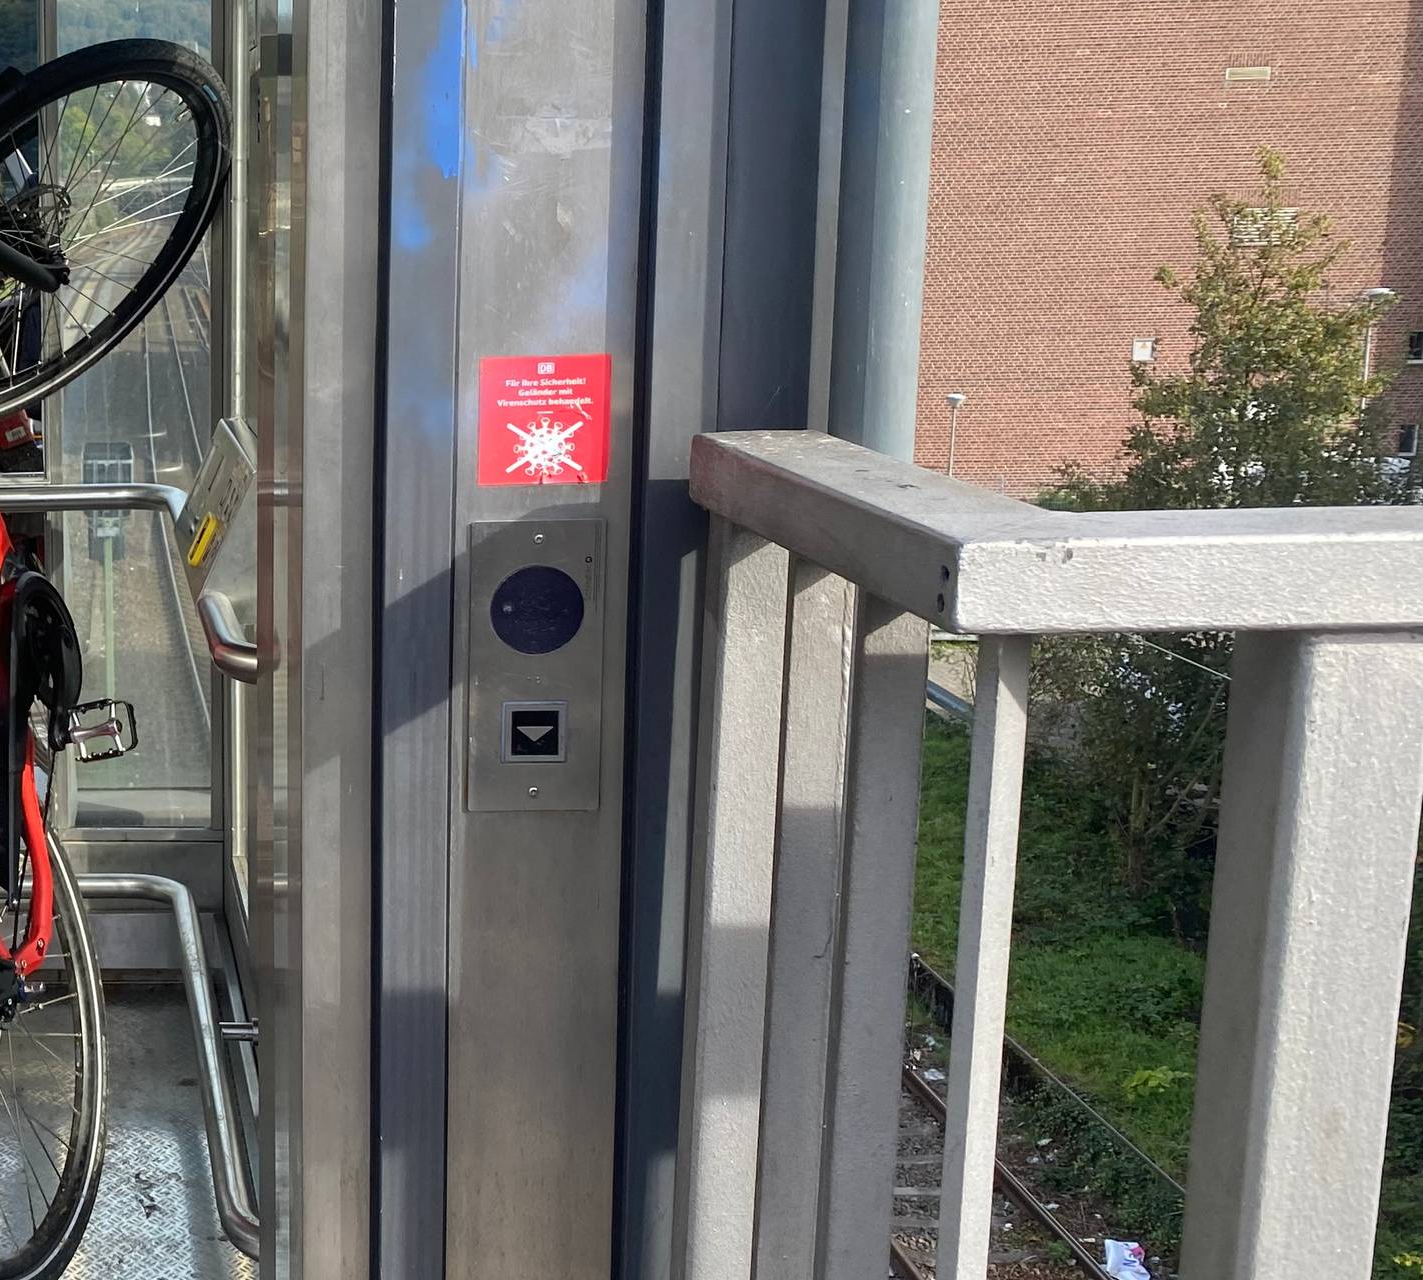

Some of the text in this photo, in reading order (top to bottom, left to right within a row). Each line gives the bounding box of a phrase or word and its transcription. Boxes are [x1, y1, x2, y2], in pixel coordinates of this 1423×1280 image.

[538, 363, 554, 374] DB
[505, 377, 586, 387] Für Ihre Sicherheit!
[518, 387, 573, 397] Geländer mit
[497, 398, 547, 407] Virenschutz
